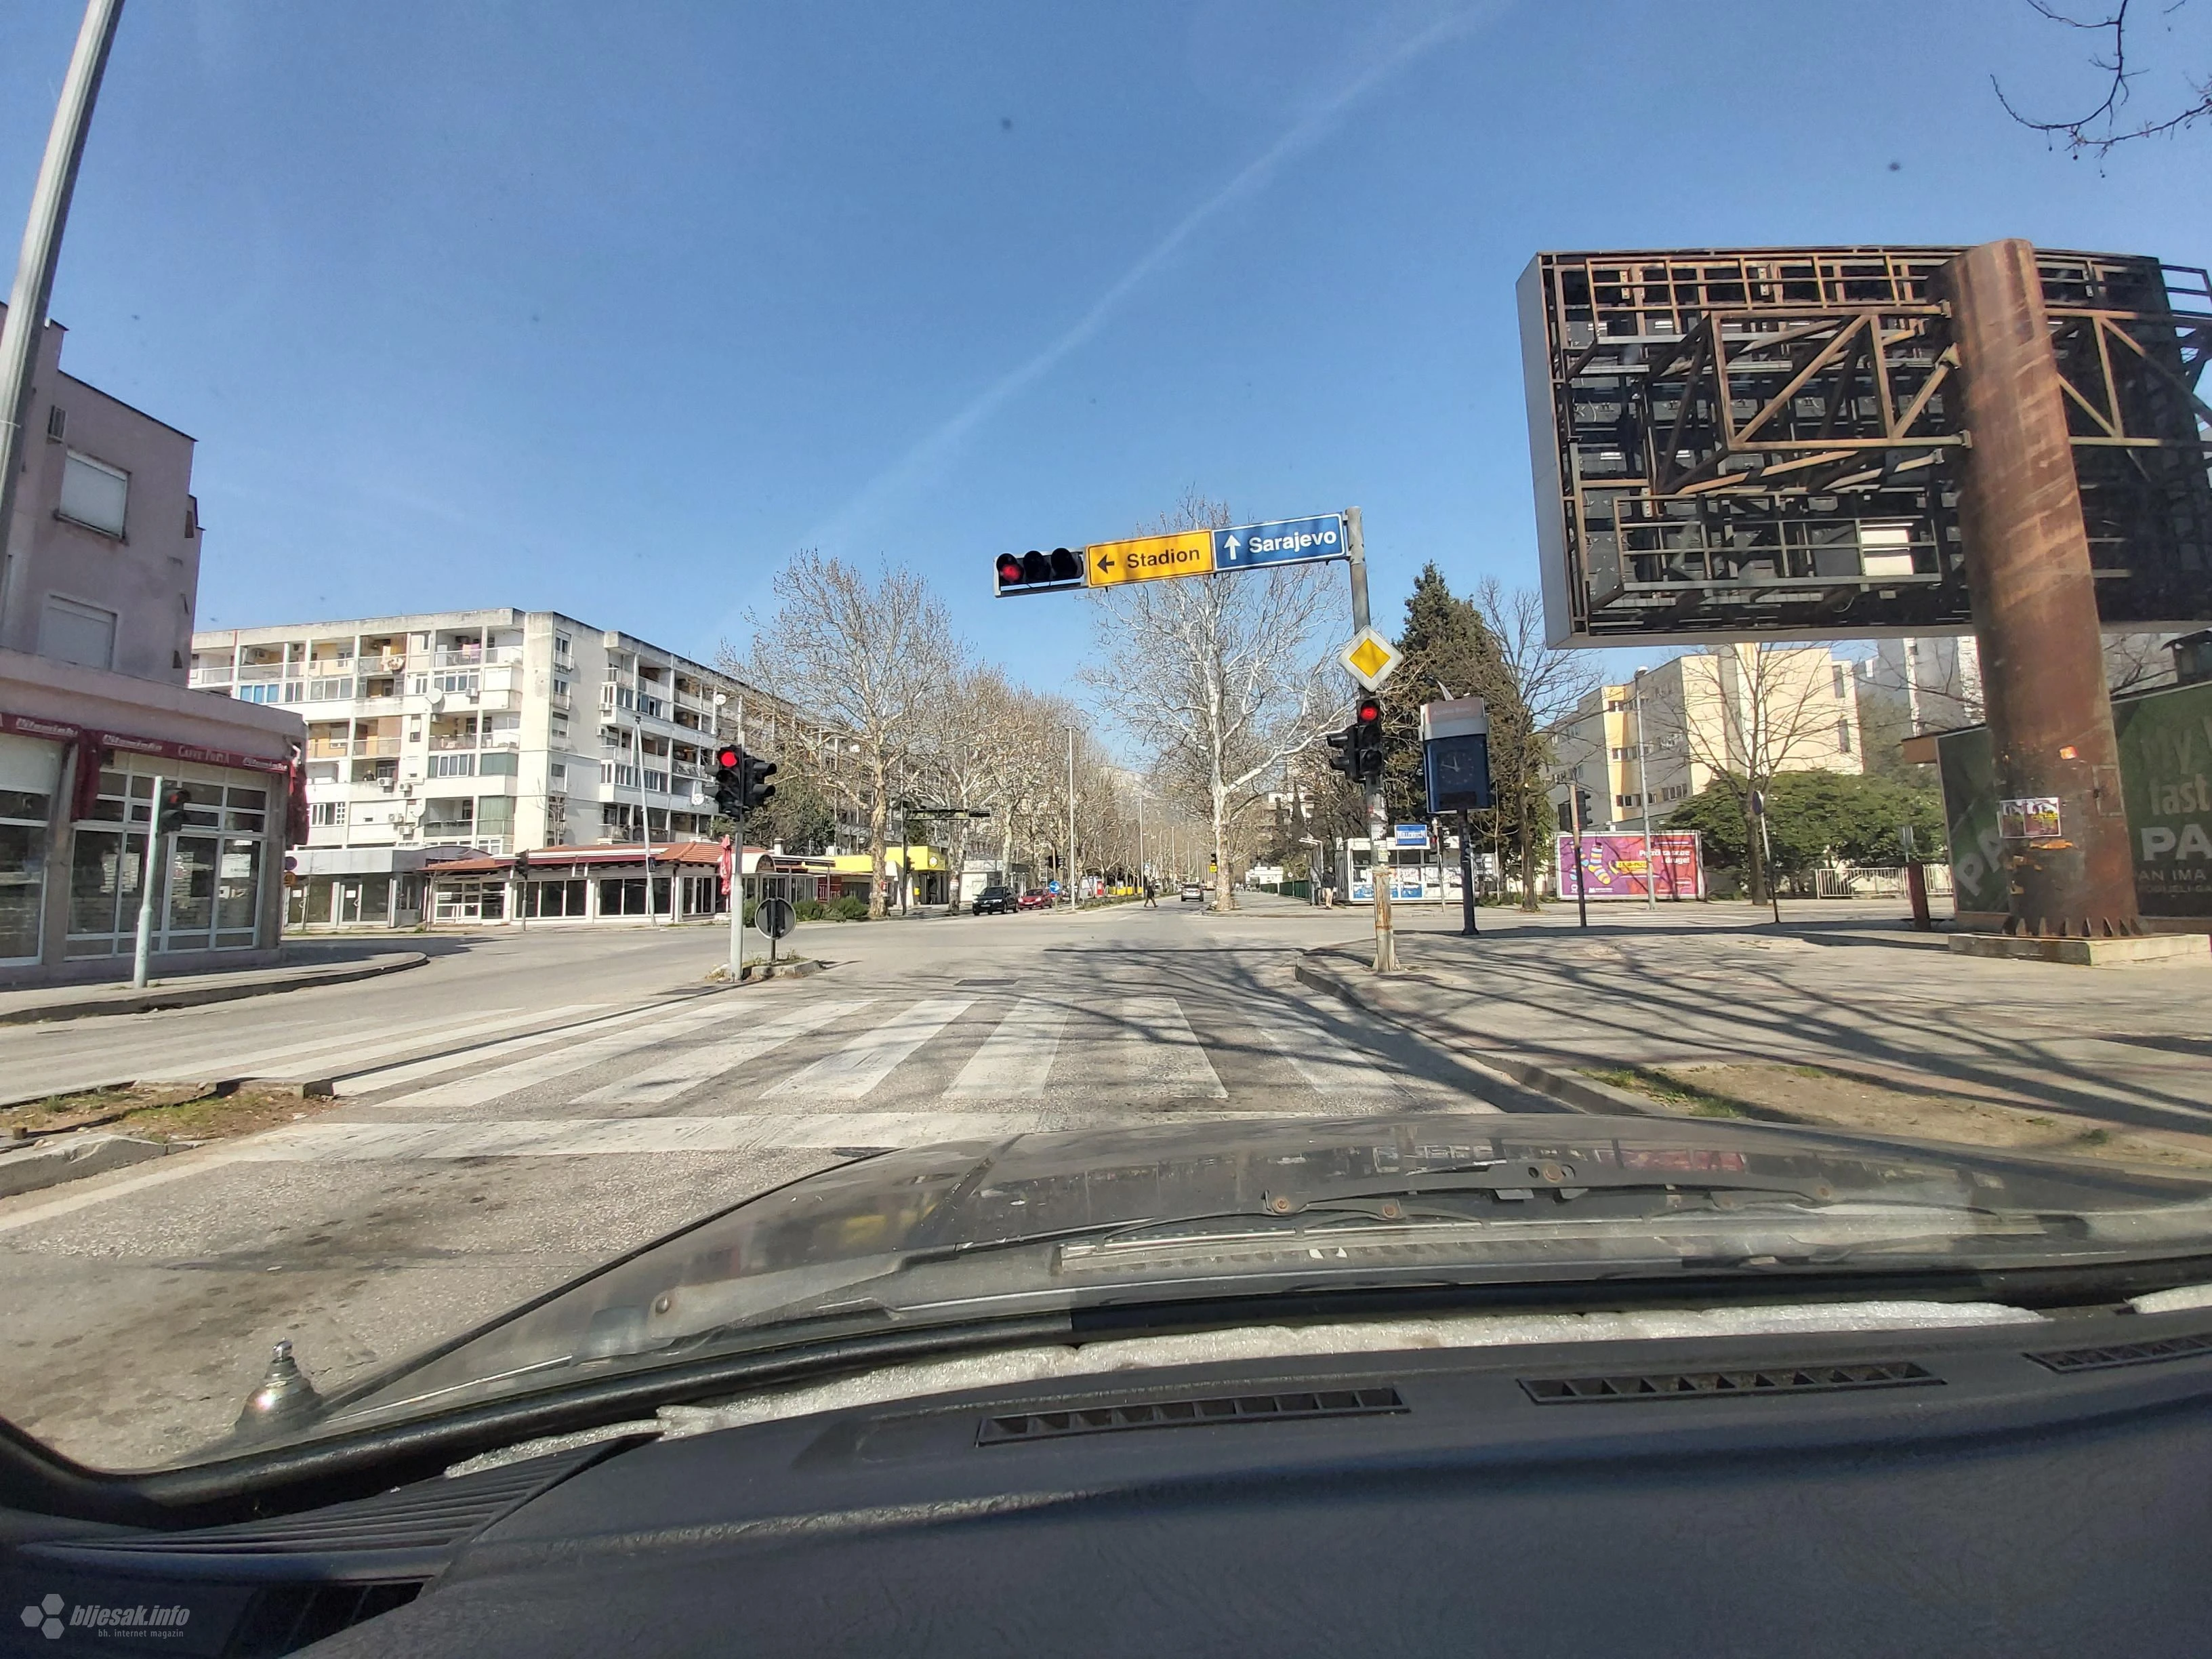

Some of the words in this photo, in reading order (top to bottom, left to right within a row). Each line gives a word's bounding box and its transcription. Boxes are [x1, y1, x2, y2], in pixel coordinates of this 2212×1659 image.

[1249, 531, 1337, 553] Sarajevo
[1127, 548, 1200, 568] Stadion
[2136, 870, 2164, 882] AN
[2172, 869, 2207, 881] IMA
